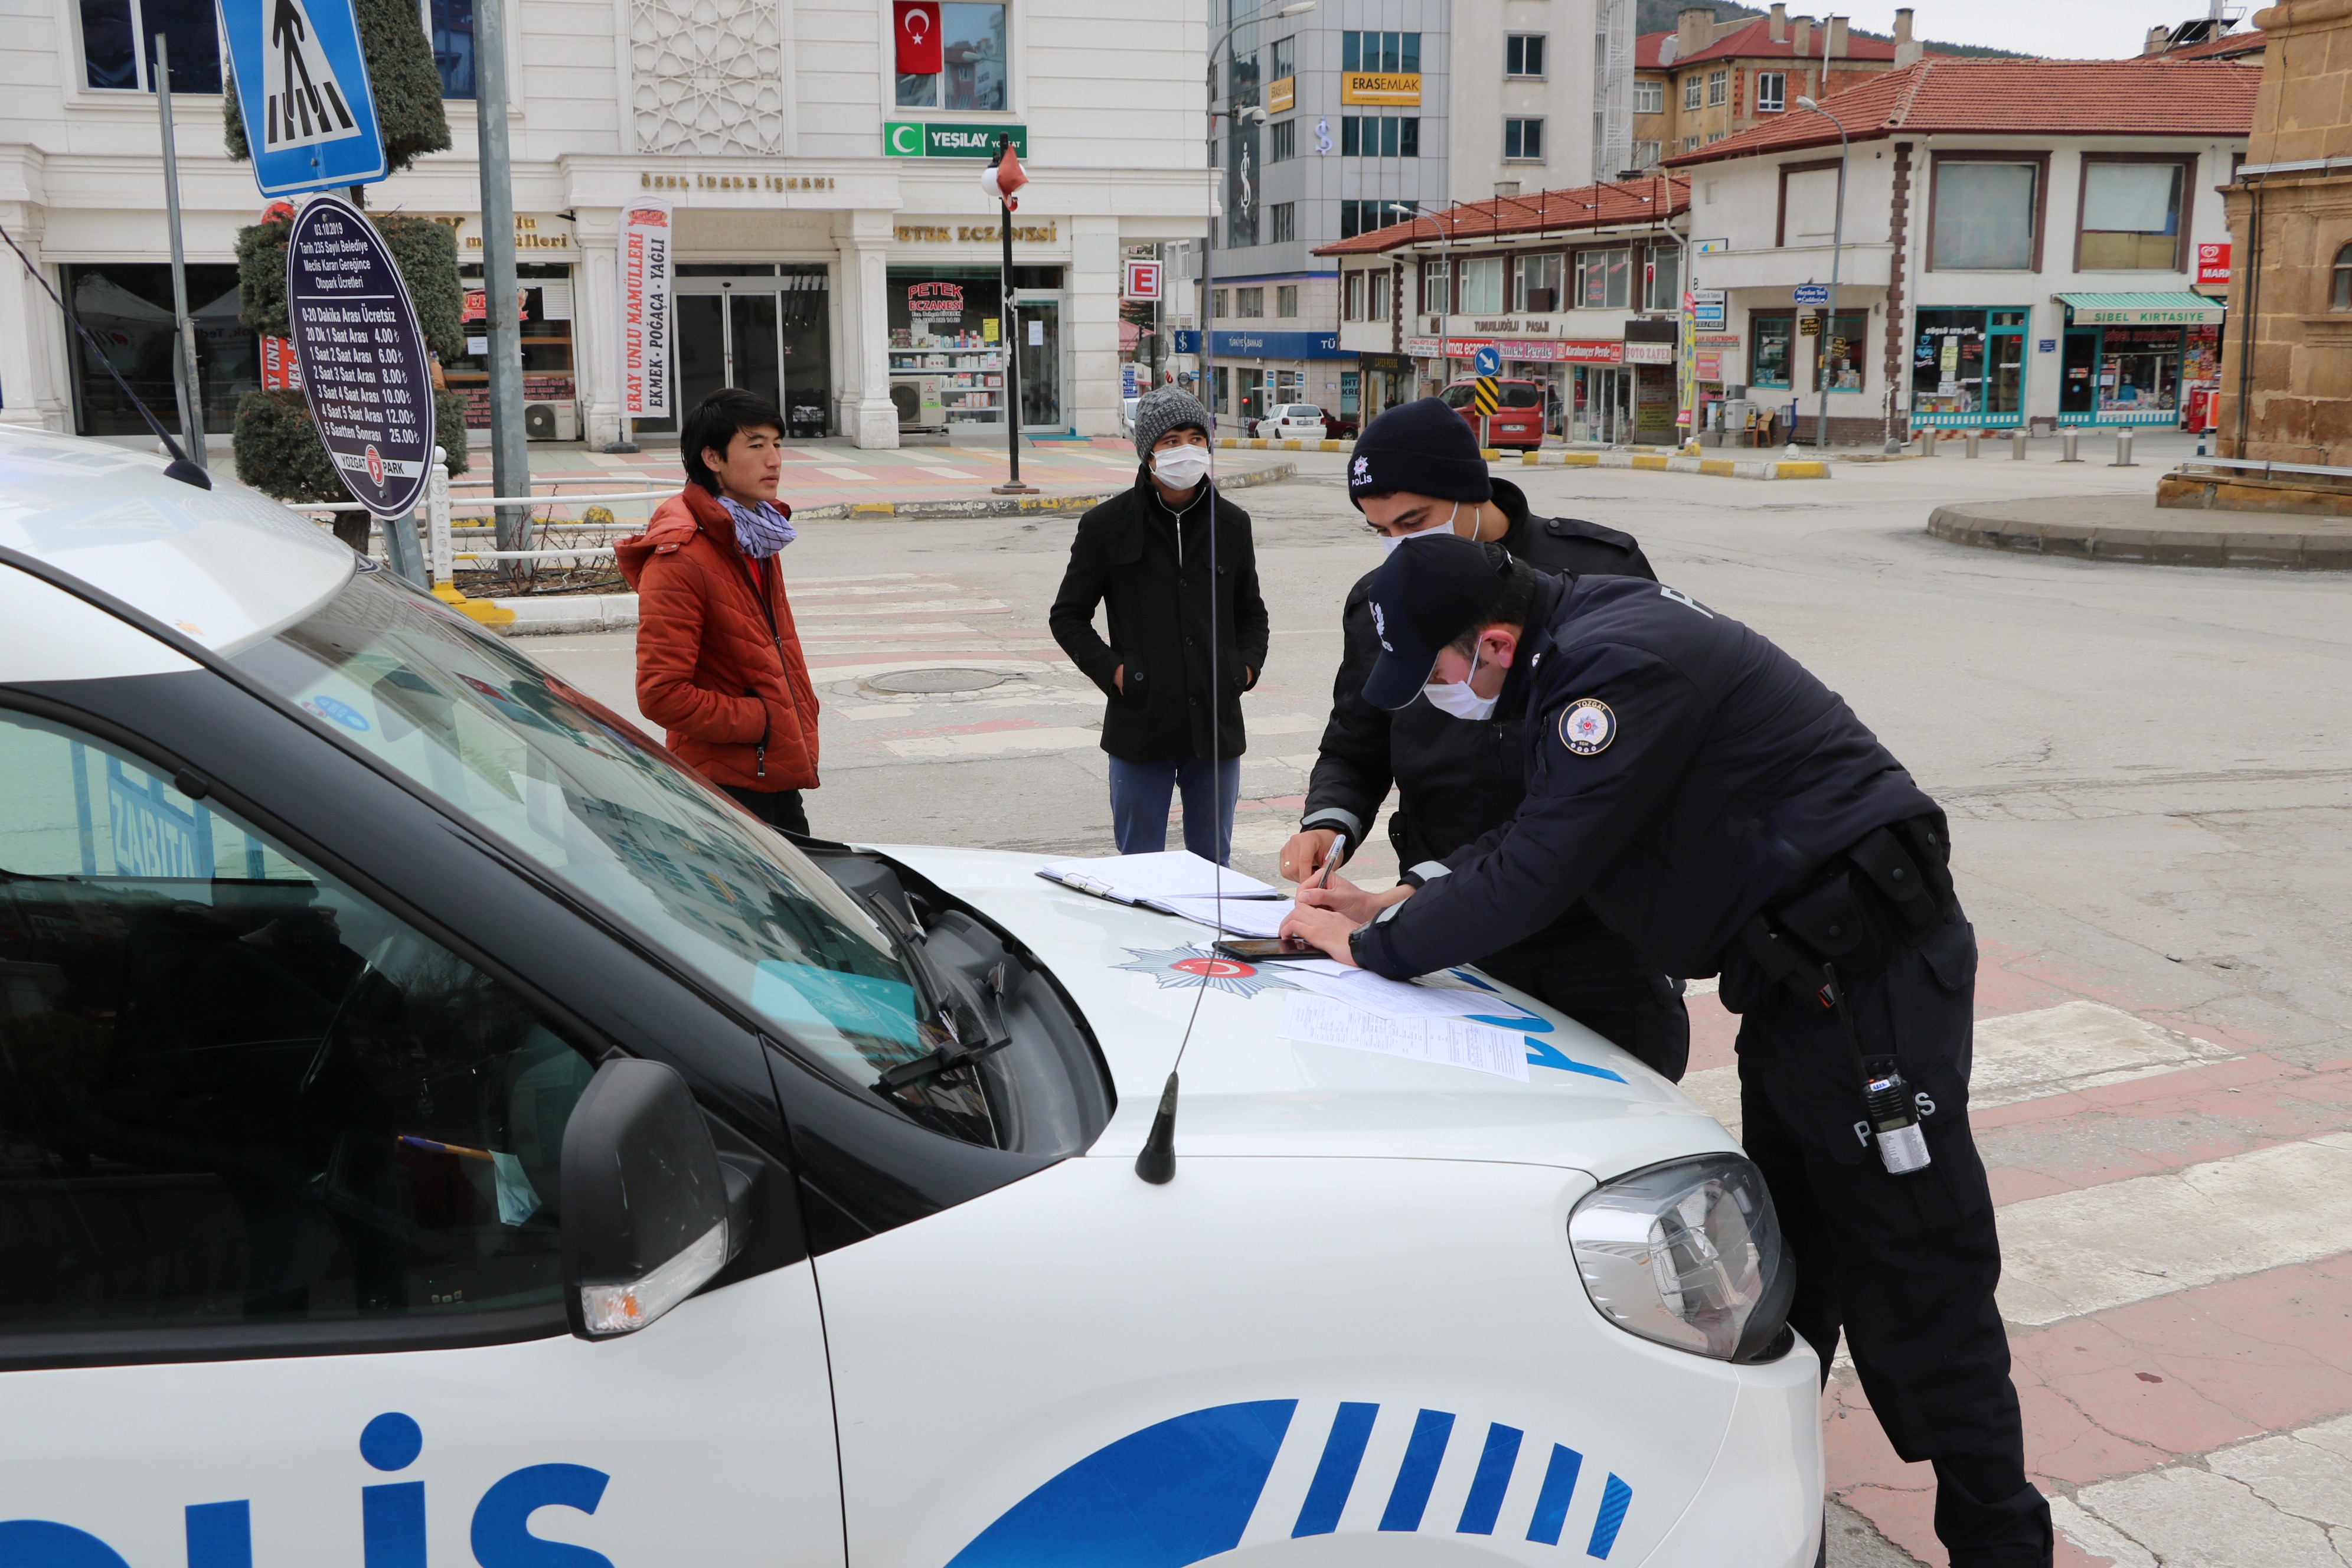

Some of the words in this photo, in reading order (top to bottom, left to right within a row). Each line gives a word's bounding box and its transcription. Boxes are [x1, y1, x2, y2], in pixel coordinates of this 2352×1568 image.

[1353, 77, 1419, 90] ERASEMLAK
[642, 172, 690, 188] ÖZEL
[698, 174, 757, 188] İDARE
[766, 174, 834, 192] İŞHANI
[314, 222, 343, 236] 03.10.2019
[893, 226, 952, 241] PETEK
[299, 241, 313, 254] Tarih
[314, 241, 325, 254] 235
[324, 241, 341, 256] Sayılı
[340, 239, 368, 254] Belediye
[303, 259, 322, 272] Meclis
[322, 259, 339, 271] Kararı
[338, 257, 371, 273] Gereğince
[647, 239, 665, 279] YAĞLI
[315, 276, 338, 292] Otopark
[338, 274, 364, 289] Ücretleri
[624, 232, 643, 326] MAMÜLLERİ
[1135, 269, 1153, 292] E
[908, 282, 964, 299] PETEK
[302, 308, 318, 322] 0-20
[317, 308, 341, 323] Dakika
[342, 308, 361, 322] Arası
[361, 303, 396, 323] Ücretsiz
[909, 298, 964, 311] ECZANESİ
[646, 293, 667, 349] POĞAÇA
[306, 327, 315, 341] 20
[316, 327, 325, 342] Dk
[326, 327, 331, 342] 1
[332, 327, 348, 343] Saat
[349, 328, 368, 344] Arası
[1247, 339, 1263, 348] BANKASI
[309, 346, 315, 361] 1
[315, 346, 331, 362] Saat
[331, 347, 336, 361] 2
[336, 347, 352, 362] Saat
[353, 348, 373, 364] Arası
[627, 328, 642, 369] UNLU
[1498, 342, 1523, 356] Emek
[1524, 342, 1552, 358] Perde
[1594, 345, 1611, 358] Perde
[1626, 347, 1645, 358] FOTO
[1646, 347, 1671, 360] ZAFER
[313, 365, 319, 380] 2
[319, 365, 335, 381] Saat
[334, 366, 339, 381] 3
[339, 367, 355, 382] Saat
[357, 367, 376, 383] Arası
[649, 359, 663, 408] EKMEK
[317, 384, 323, 398] 3
[323, 384, 338, 400] Saat
[338, 386, 344, 400] 4
[344, 386, 360, 402] Saat
[361, 387, 380, 403] Arası
[627, 373, 642, 413] ERAY
[322, 403, 327, 417] 4
[327, 403, 342, 419] Saat
[342, 405, 348, 419] 5
[348, 405, 364, 421] Saat
[365, 407, 384, 423] Arası
[324, 422, 331, 436] 5
[331, 422, 355, 439] Saatten
[355, 424, 382, 442] Sonrası
[341, 455, 366, 471] YOZGAT
[383, 462, 405, 475] PARK
[1576, 701, 1606, 712] YOZGAT
[111, 789, 196, 877] ZABITA
